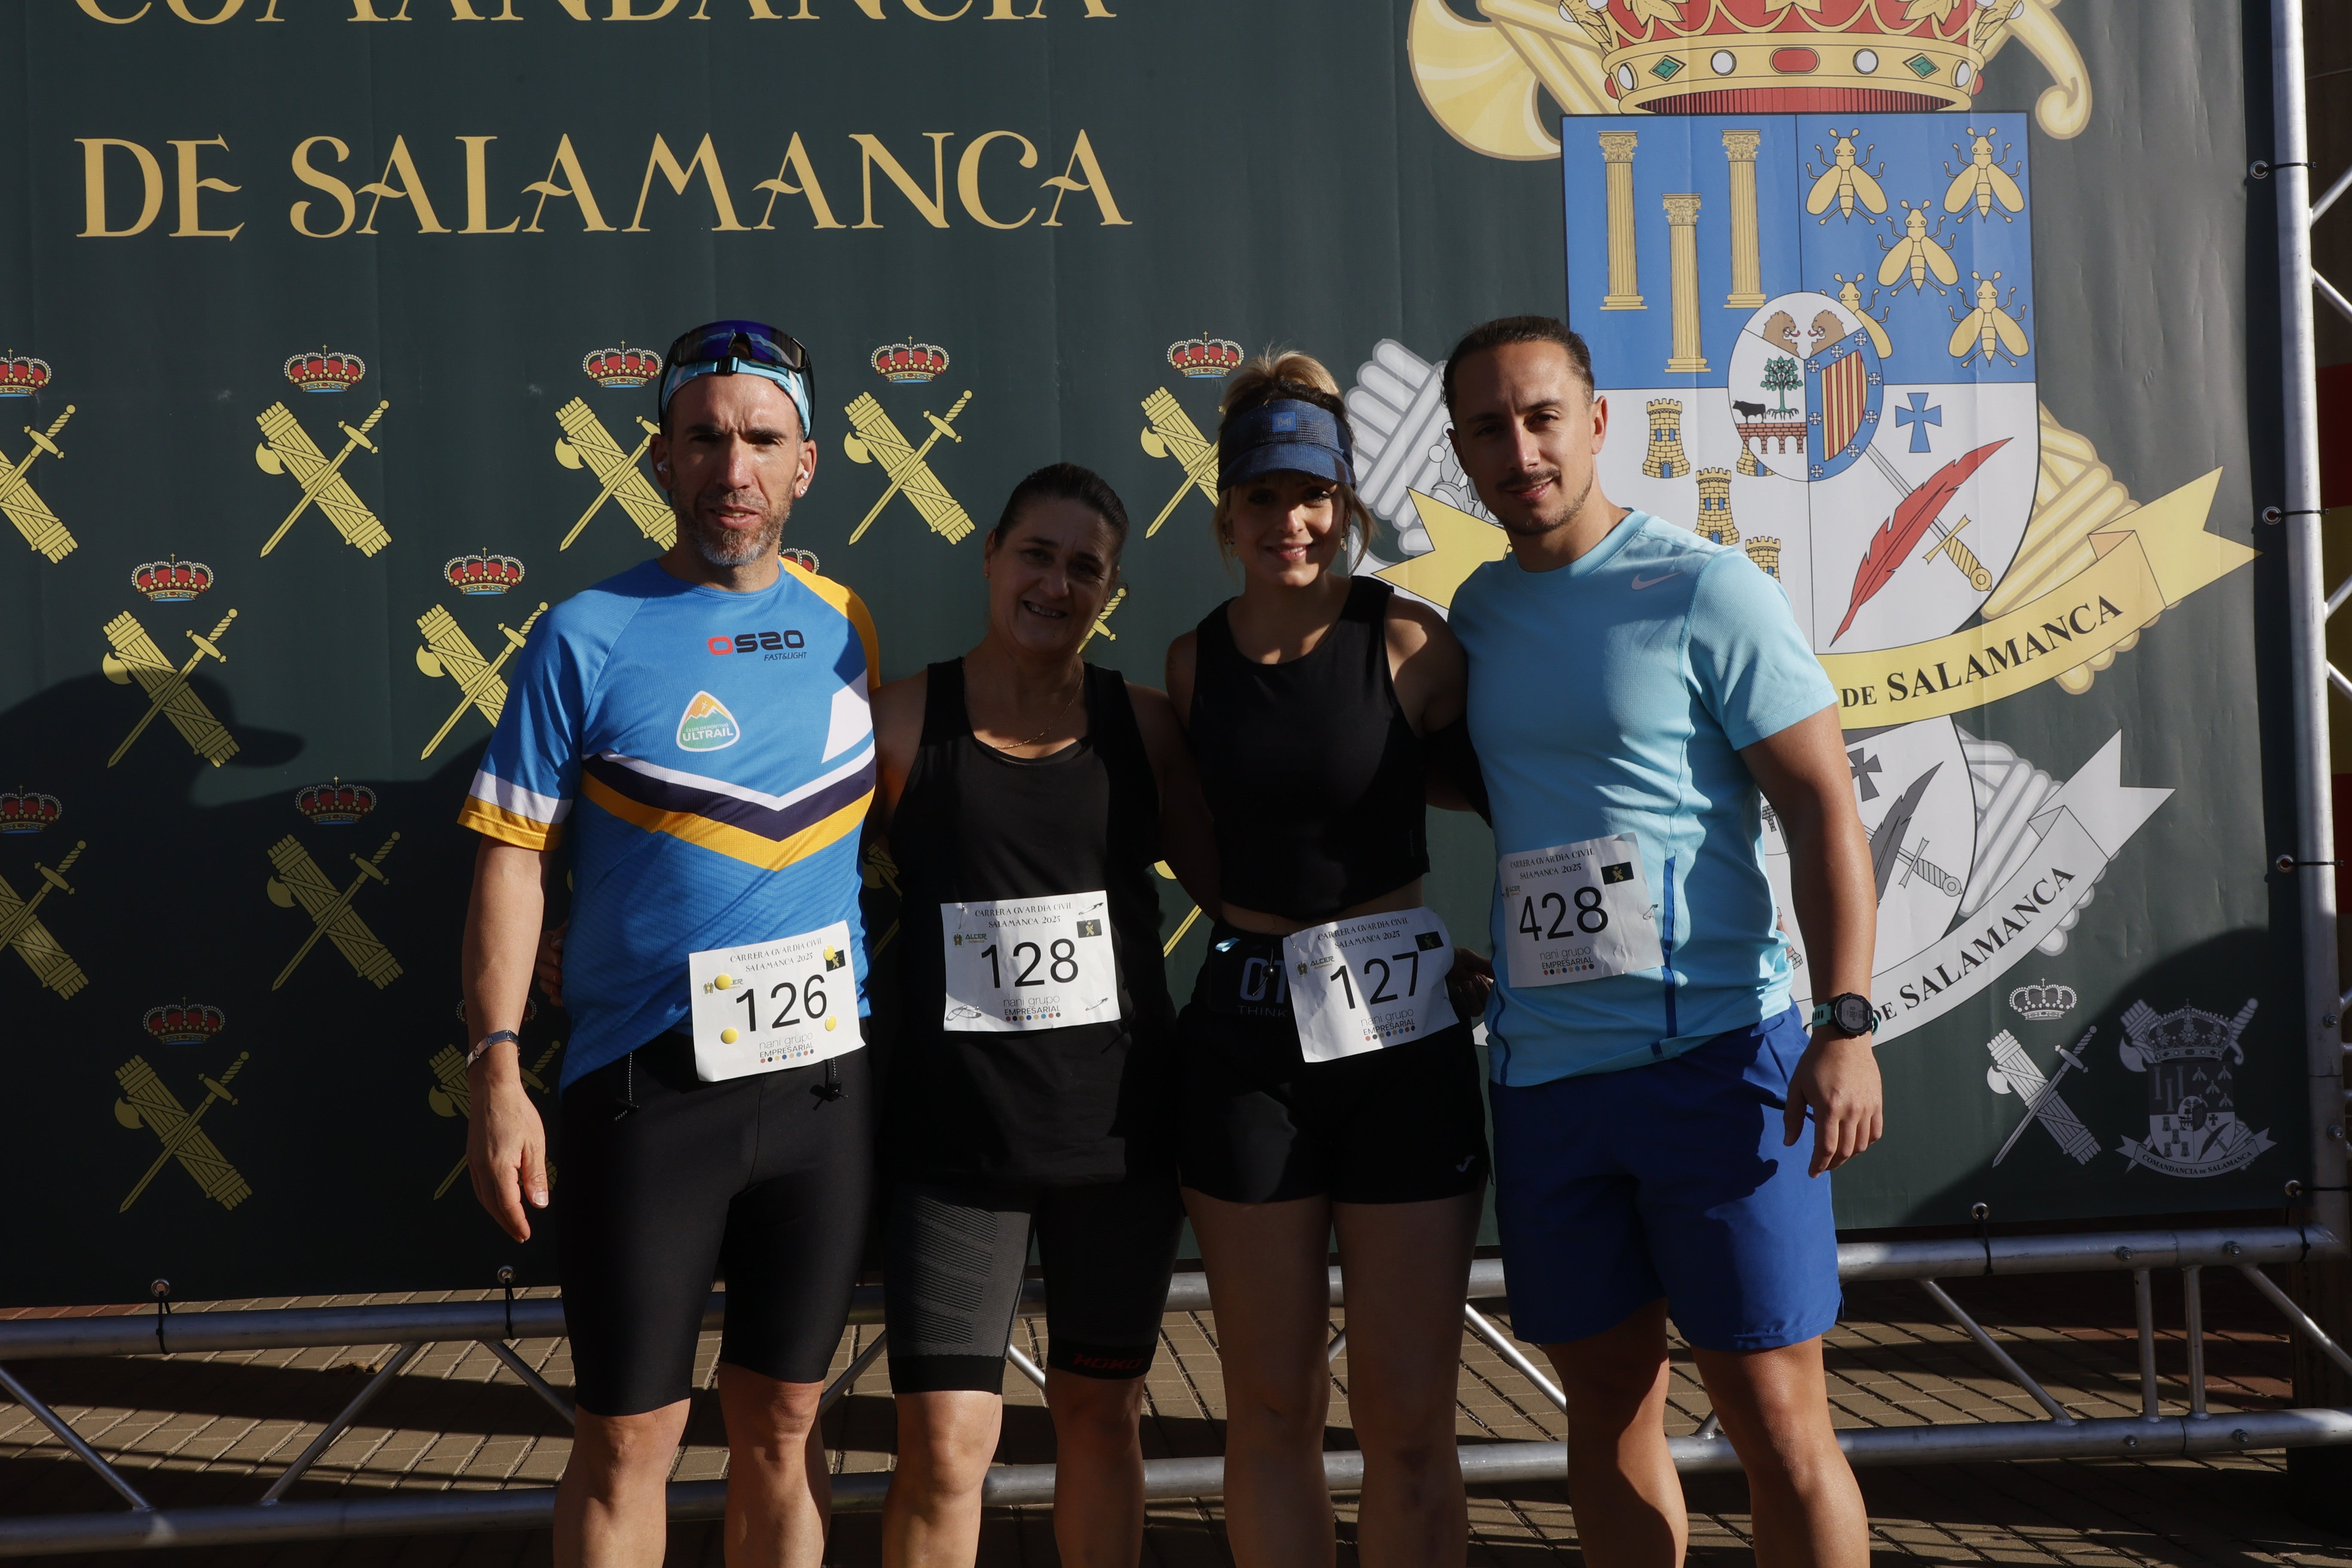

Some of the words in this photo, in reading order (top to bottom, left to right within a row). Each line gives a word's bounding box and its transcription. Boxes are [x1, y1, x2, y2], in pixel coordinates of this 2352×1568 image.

[75, 134, 245, 242] DE
[289, 129, 1132, 239] SALAMANCA
[764, 652, 807, 661] FAST&LIGHT
[1841, 686, 1877, 708] DE
[1887, 595, 2124, 702] SALAMANCA
[683, 728, 734, 741] ULTRAIL
[1520, 868, 1559, 880] SALAMANCA
[1561, 863, 1581, 873] 2025
[975, 908, 1011, 917] CARRERA
[1519, 886, 1608, 941] 428
[989, 918, 1039, 928] SALAMANCA
[1042, 916, 1060, 925] 2025
[1318, 927, 1357, 941] CARRERA
[1335, 935, 1382, 949] SALAMANCA
[1383, 930, 1400, 940] 2025
[1899, 867, 2075, 1011] SALAMANCA
[730, 951, 770, 963] CARRERA
[1540, 948, 1559, 960] nani
[1562, 946, 1591, 959] grupo
[745, 958, 794, 972] SALAMANCA
[796, 952, 814, 963] 2025
[981, 938, 1078, 989] 128
[1542, 956, 1593, 968] EMPRESARIAL
[1330, 951, 1418, 1009] 127
[736, 974, 827, 1032] 126
[1004, 996, 1025, 1007] nani
[1028, 995, 1060, 1008] grupo
[1004, 1005, 1060, 1016] EMPRESARIAL
[1237, 1005, 1288, 1017] THINK
[1361, 1014, 1383, 1027] nani
[1385, 1009, 1414, 1023] grupo
[1363, 1018, 1415, 1036] EMPRESARIAL
[759, 1037, 781, 1050] nani
[784, 1032, 813, 1047] grupo
[760, 1043, 814, 1058] EMPRESARIAL
[2142, 1154, 2198, 1174] COMANDANCIA
[2208, 1152, 2252, 1173] SALAMANCA
